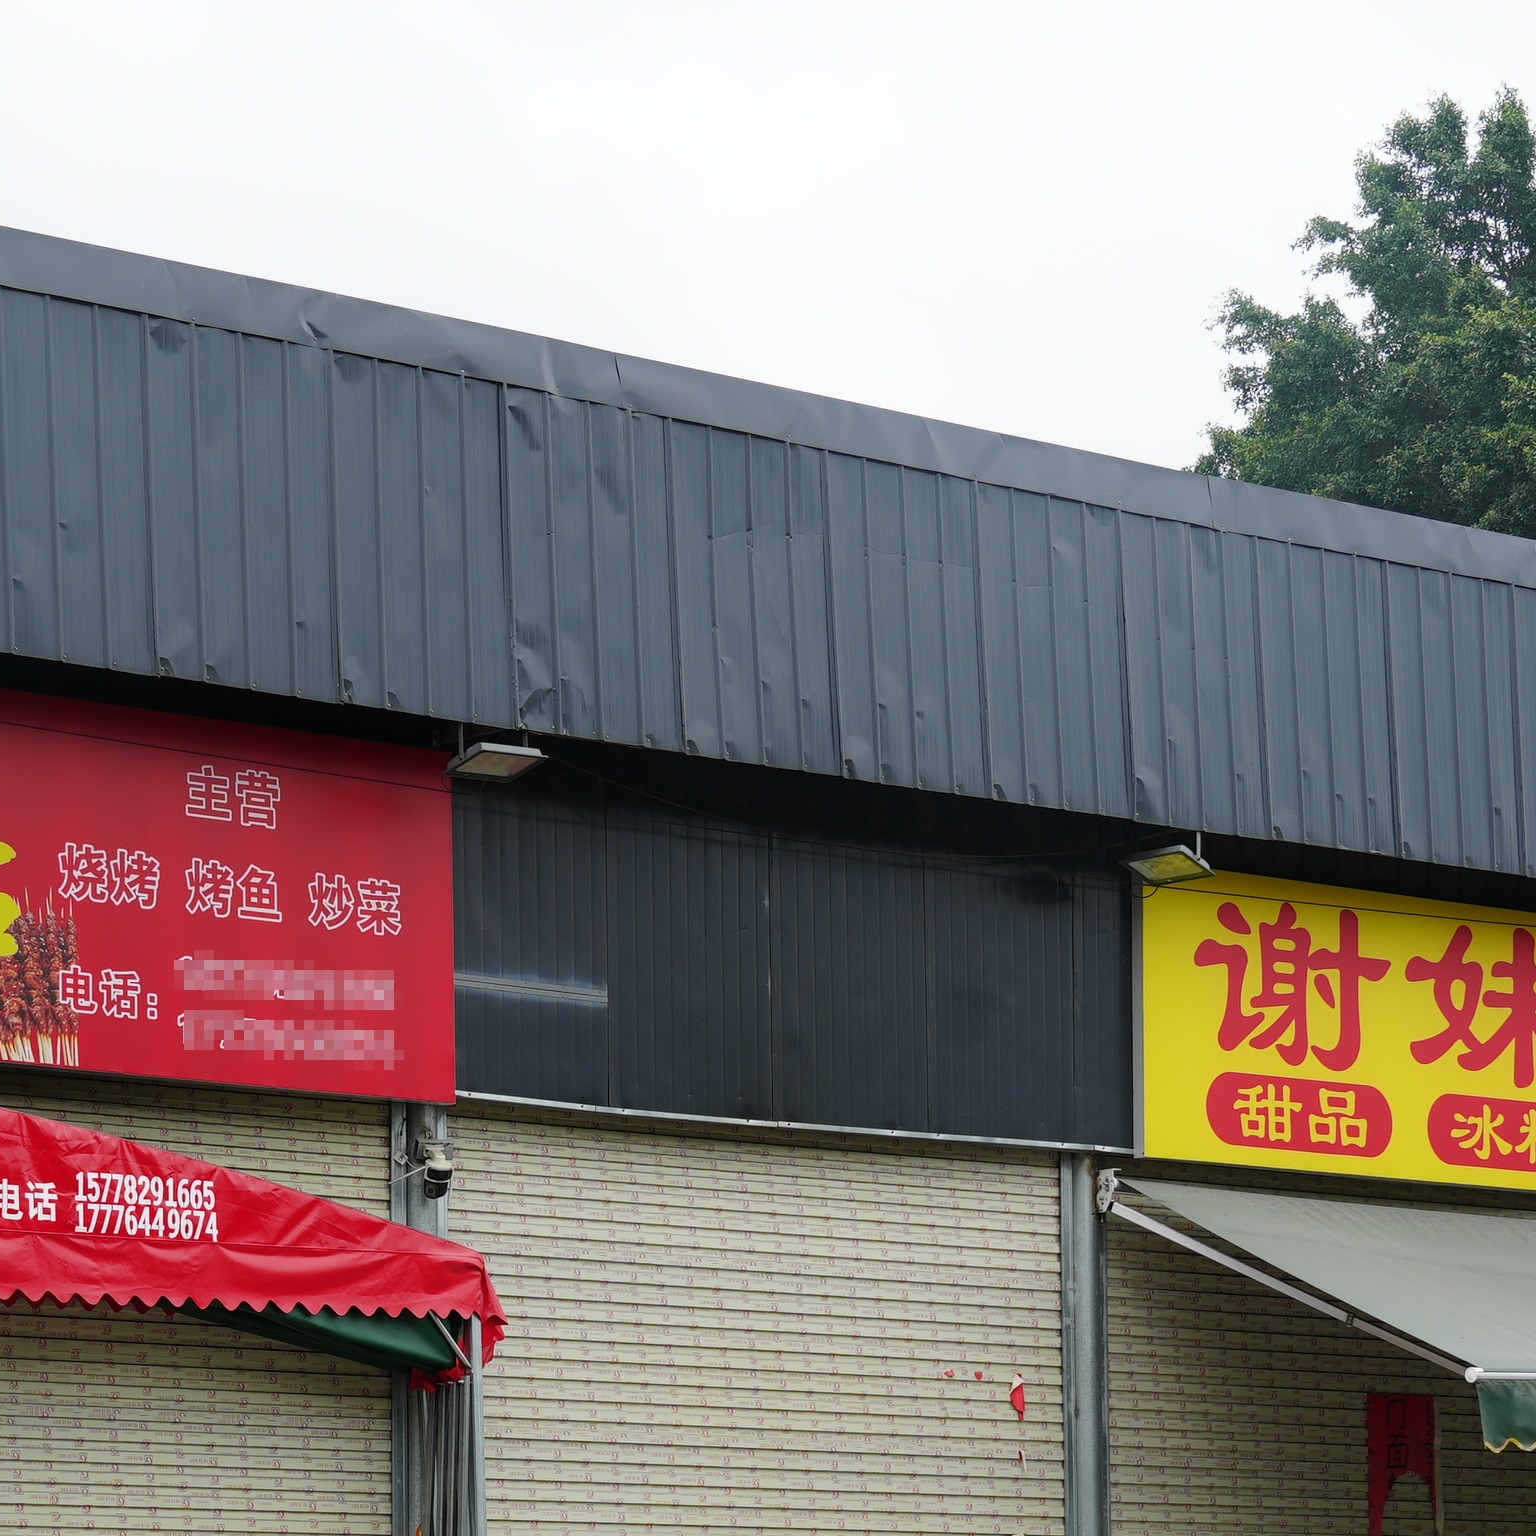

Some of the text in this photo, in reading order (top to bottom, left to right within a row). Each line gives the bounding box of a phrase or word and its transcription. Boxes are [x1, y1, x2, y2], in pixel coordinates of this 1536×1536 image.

[184, 764, 282, 831] 主营
[57, 841, 403, 937] 烧烤 烤鱼 炒菜
[1232, 1082, 1370, 1150] 甜品
[74, 1170, 215, 1210] 15778291665
[74, 1202, 219, 1243] 17776449674
